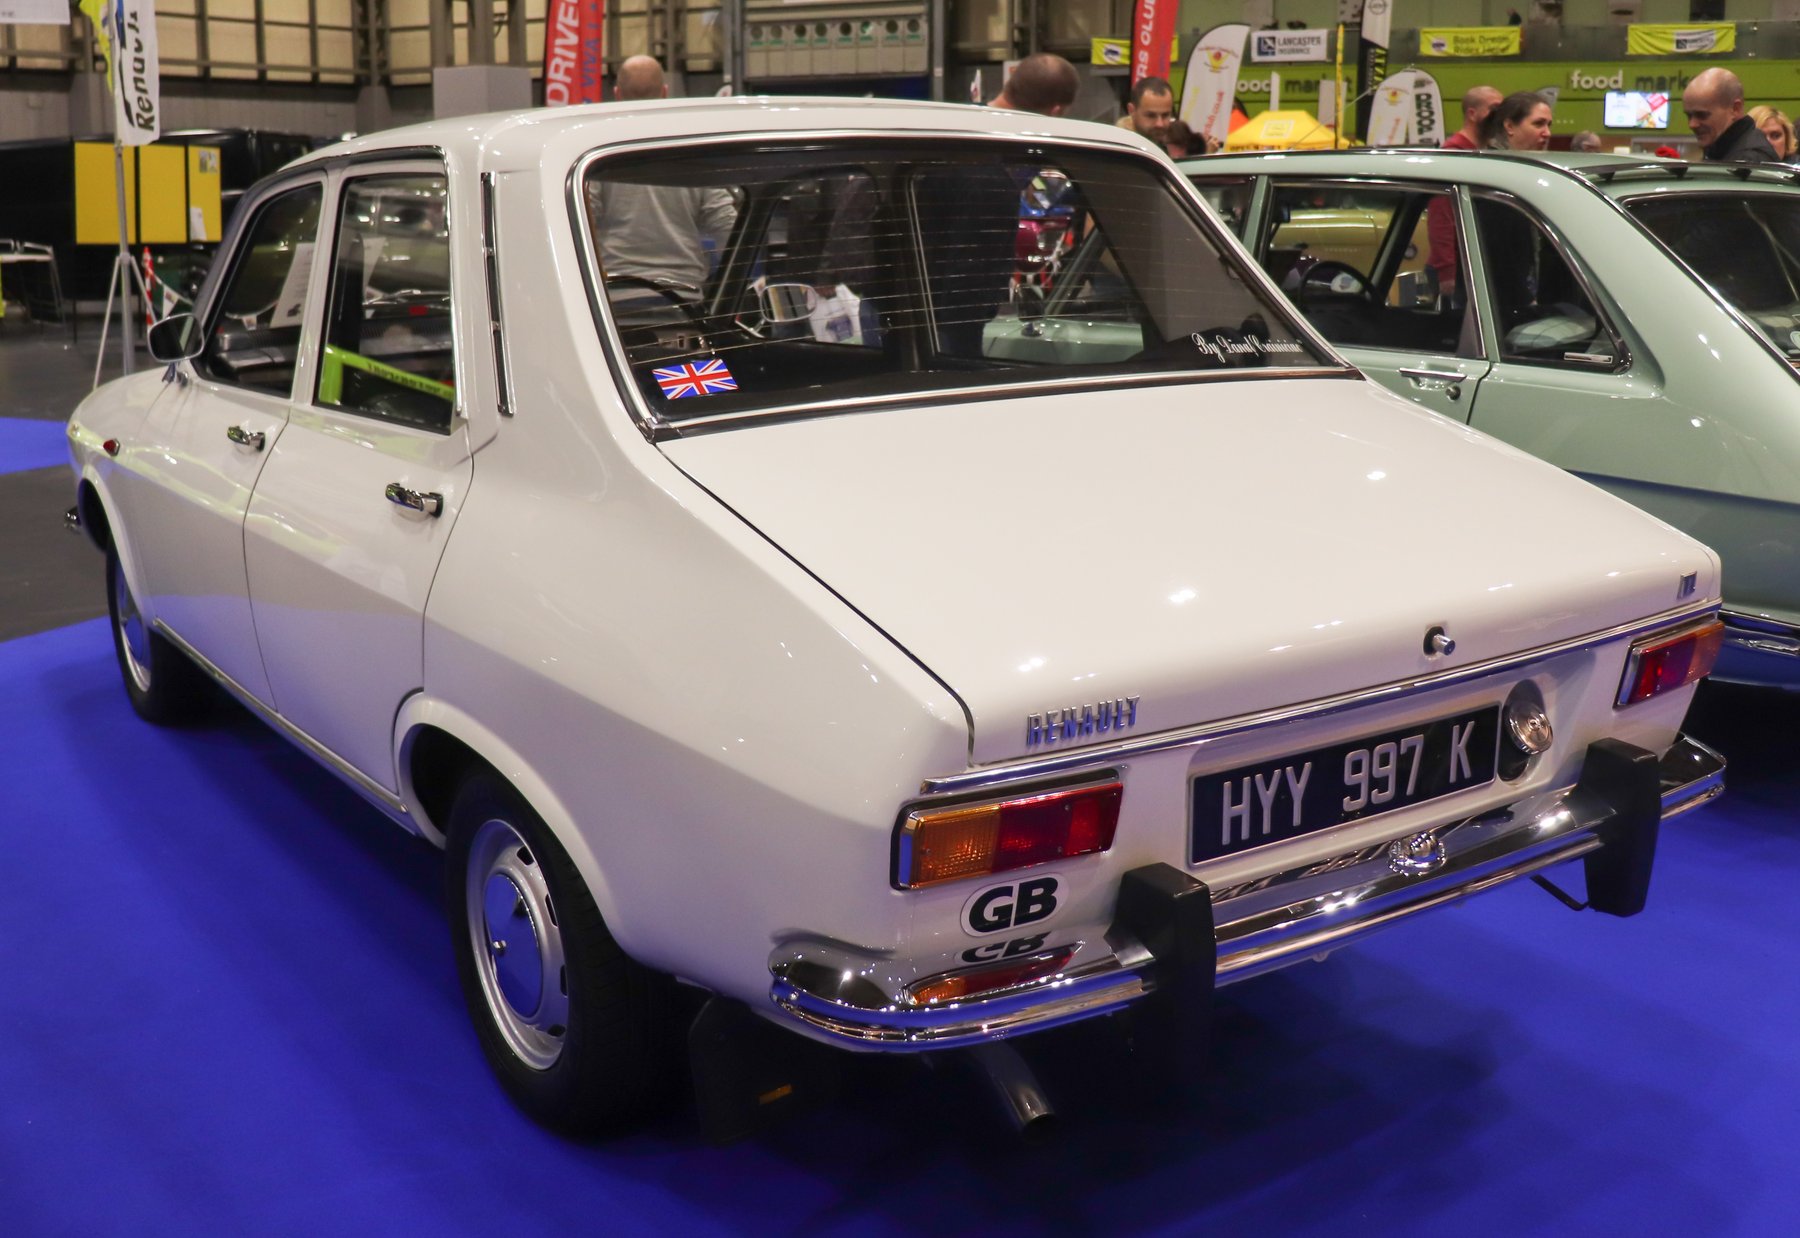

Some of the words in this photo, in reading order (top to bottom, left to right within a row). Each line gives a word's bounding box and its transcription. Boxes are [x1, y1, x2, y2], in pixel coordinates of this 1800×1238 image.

[547, 0, 580, 107] DRIVE
[1278, 36, 1321, 46] LANCASTER
[1571, 69, 1623, 89] food
[1191, 332, 1225, 363] By
[1026, 695, 1140, 746] RENAULT
[1222, 761, 1312, 846] HYY
[1342, 734, 1425, 812] 997
[1449, 720, 1475, 784] K
[969, 877, 1058, 933] GB
